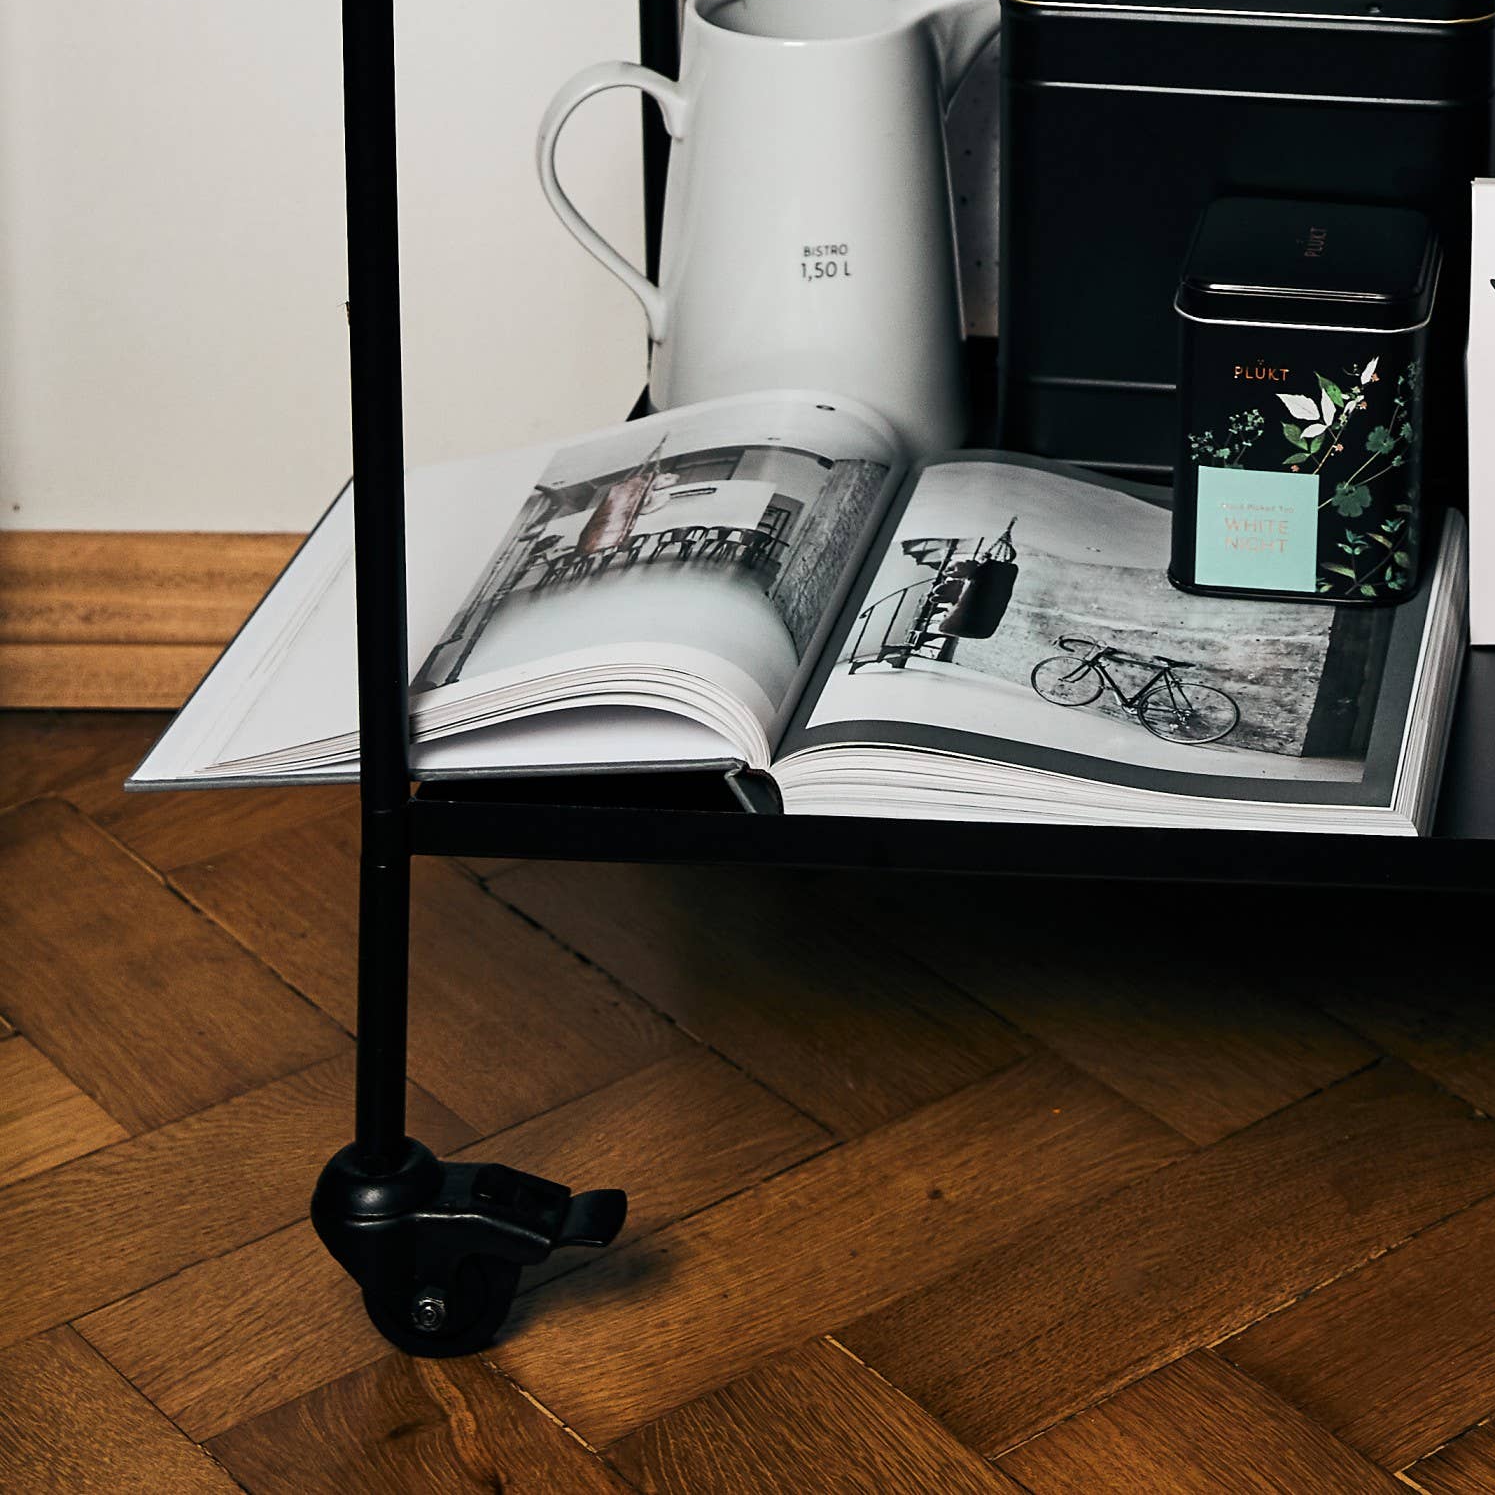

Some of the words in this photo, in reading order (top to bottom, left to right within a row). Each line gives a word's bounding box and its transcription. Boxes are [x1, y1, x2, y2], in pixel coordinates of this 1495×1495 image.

[803, 244, 848, 257] BISTRO
[801, 261, 838, 282] 1,50
[844, 261, 851, 276] L
[1224, 517, 1289, 535] WHITE
